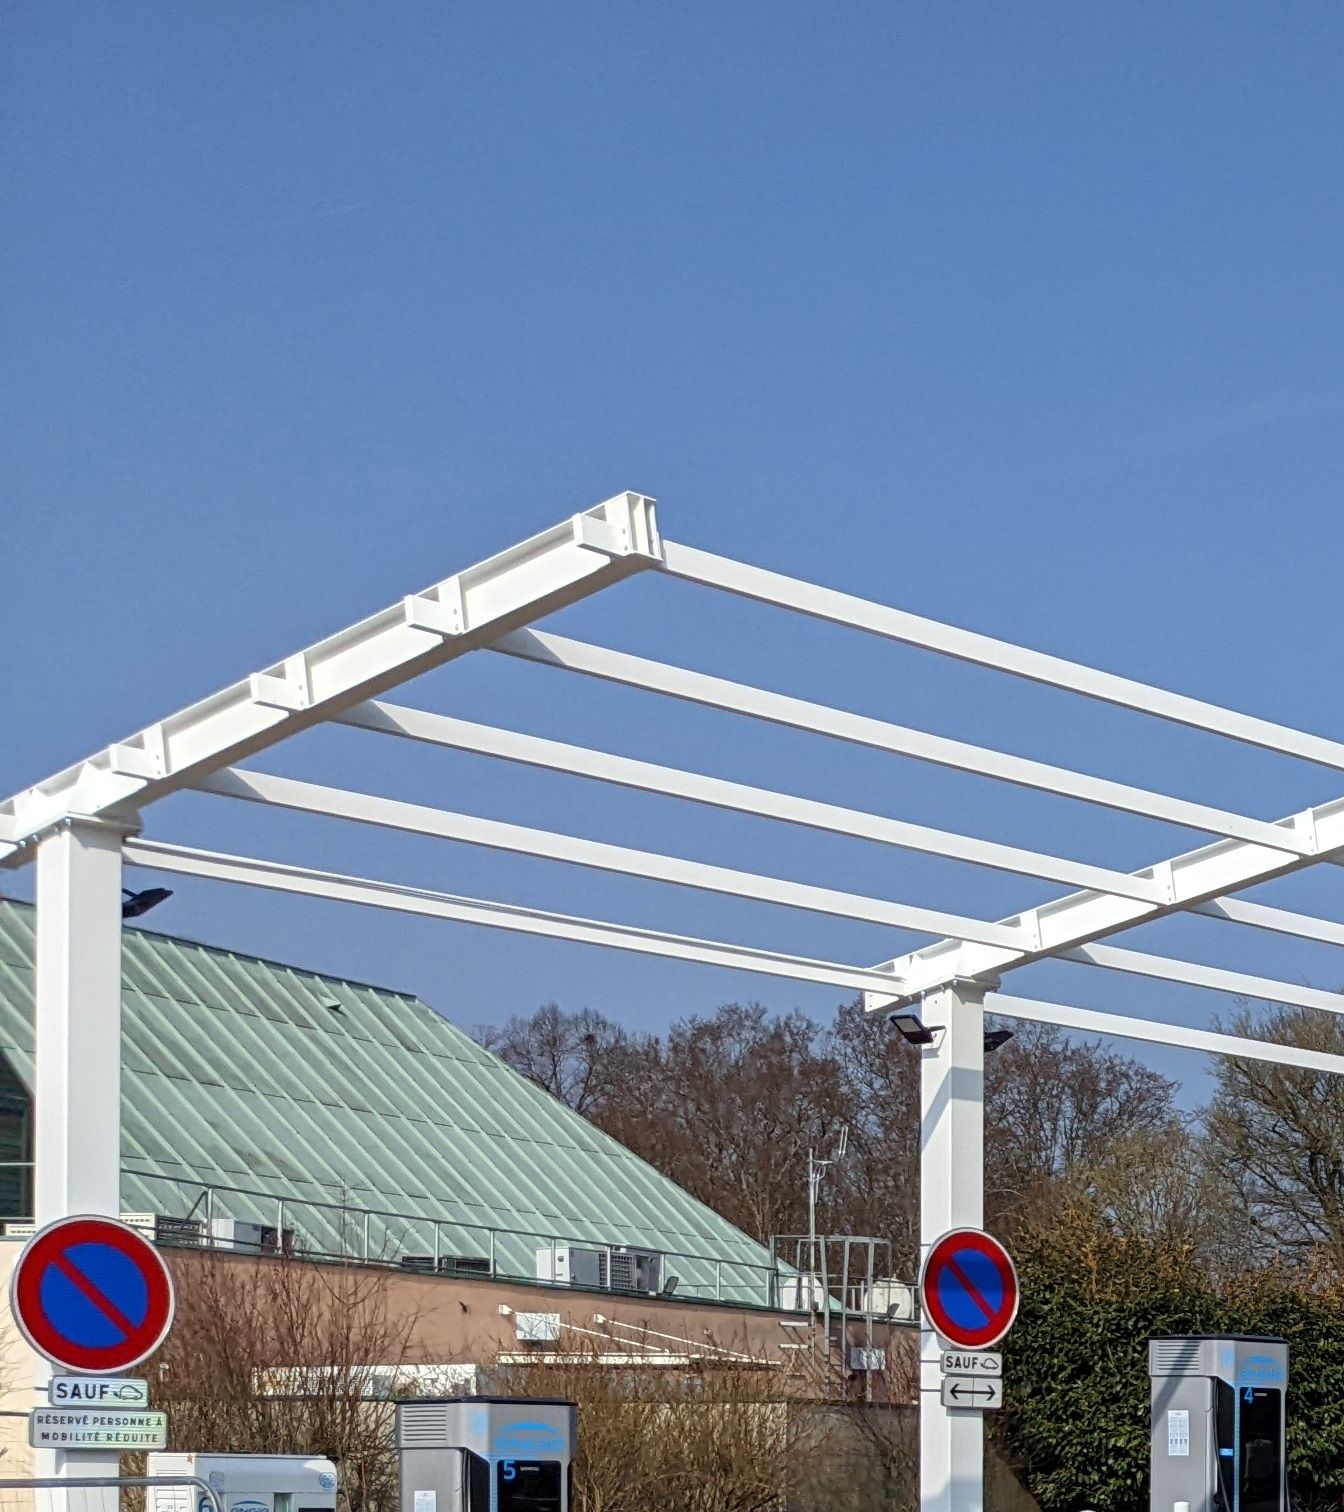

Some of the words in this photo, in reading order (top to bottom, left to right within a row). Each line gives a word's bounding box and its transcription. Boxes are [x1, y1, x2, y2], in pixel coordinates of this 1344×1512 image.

[946, 1356, 978, 1369] SAUF
[56, 1383, 110, 1399] SAUF
[37, 1415, 89, 1425] RÉSERVÉ
[93, 1416, 152, 1426] PERSONNE
[41, 1431, 100, 1442] MOBILITÉ
[106, 1432, 158, 1442] RÉDUITE
[503, 1457, 516, 1480] 5
